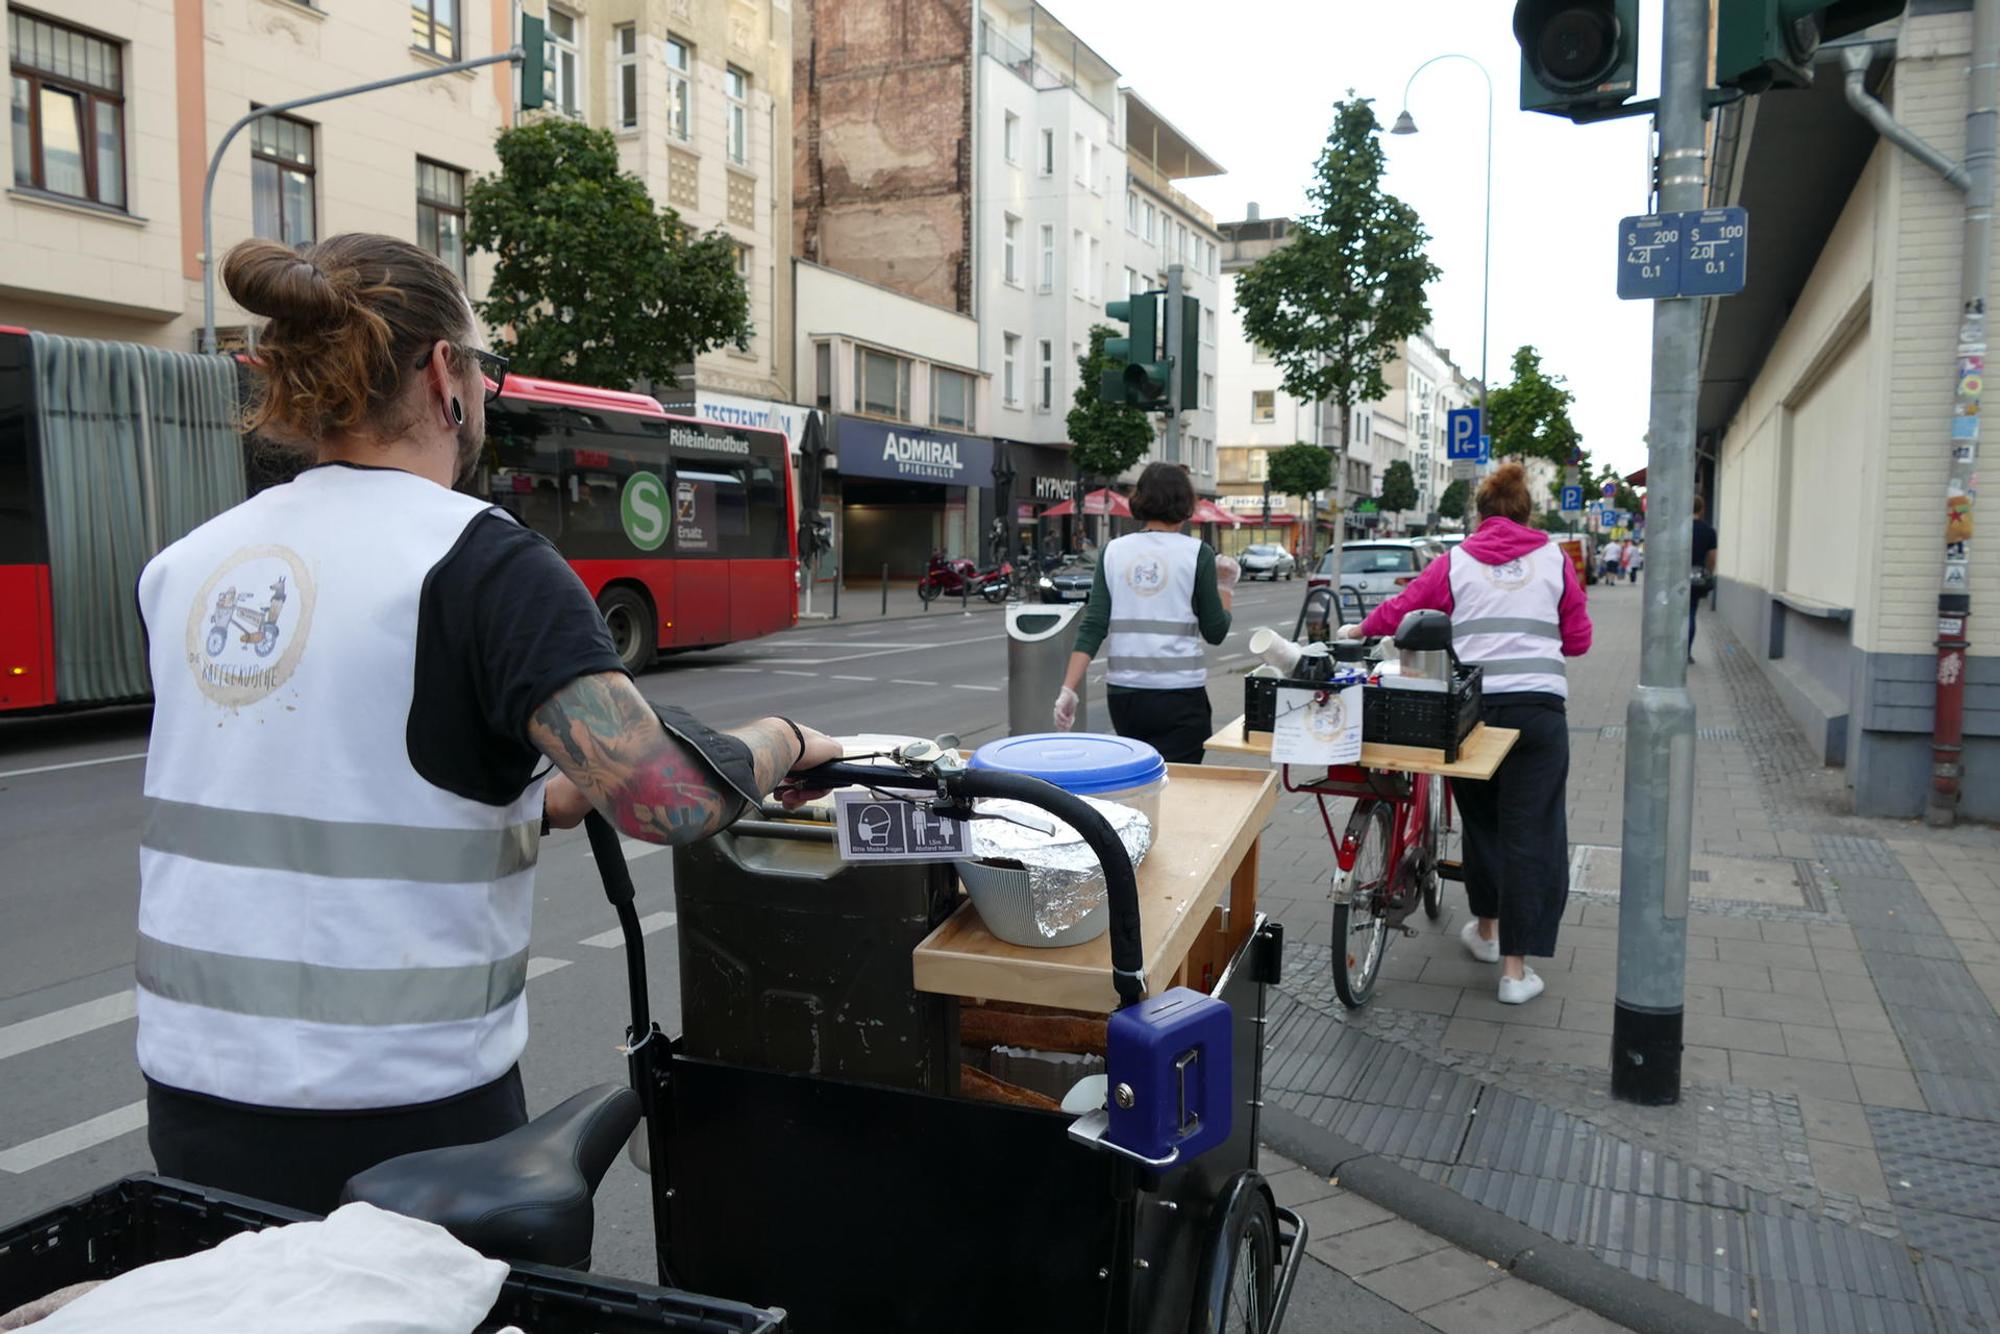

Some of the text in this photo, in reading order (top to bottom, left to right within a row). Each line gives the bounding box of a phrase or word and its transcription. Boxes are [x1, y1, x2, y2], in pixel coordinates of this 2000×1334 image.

[1627, 231, 1679, 246] S 200
[1691, 225, 1744, 241] S 100
[1627, 251, 1646, 264] 4.2
[1690, 246, 1710, 260] 2.0
[1641, 265, 1661, 278] 0.1
[1705, 261, 1725, 274] 0.1
[669, 428, 750, 455] Rheinlandbus
[1454, 415, 1472, 453] P
[883, 431, 963, 470] ADMIRAL
[629, 480, 663, 542] S
